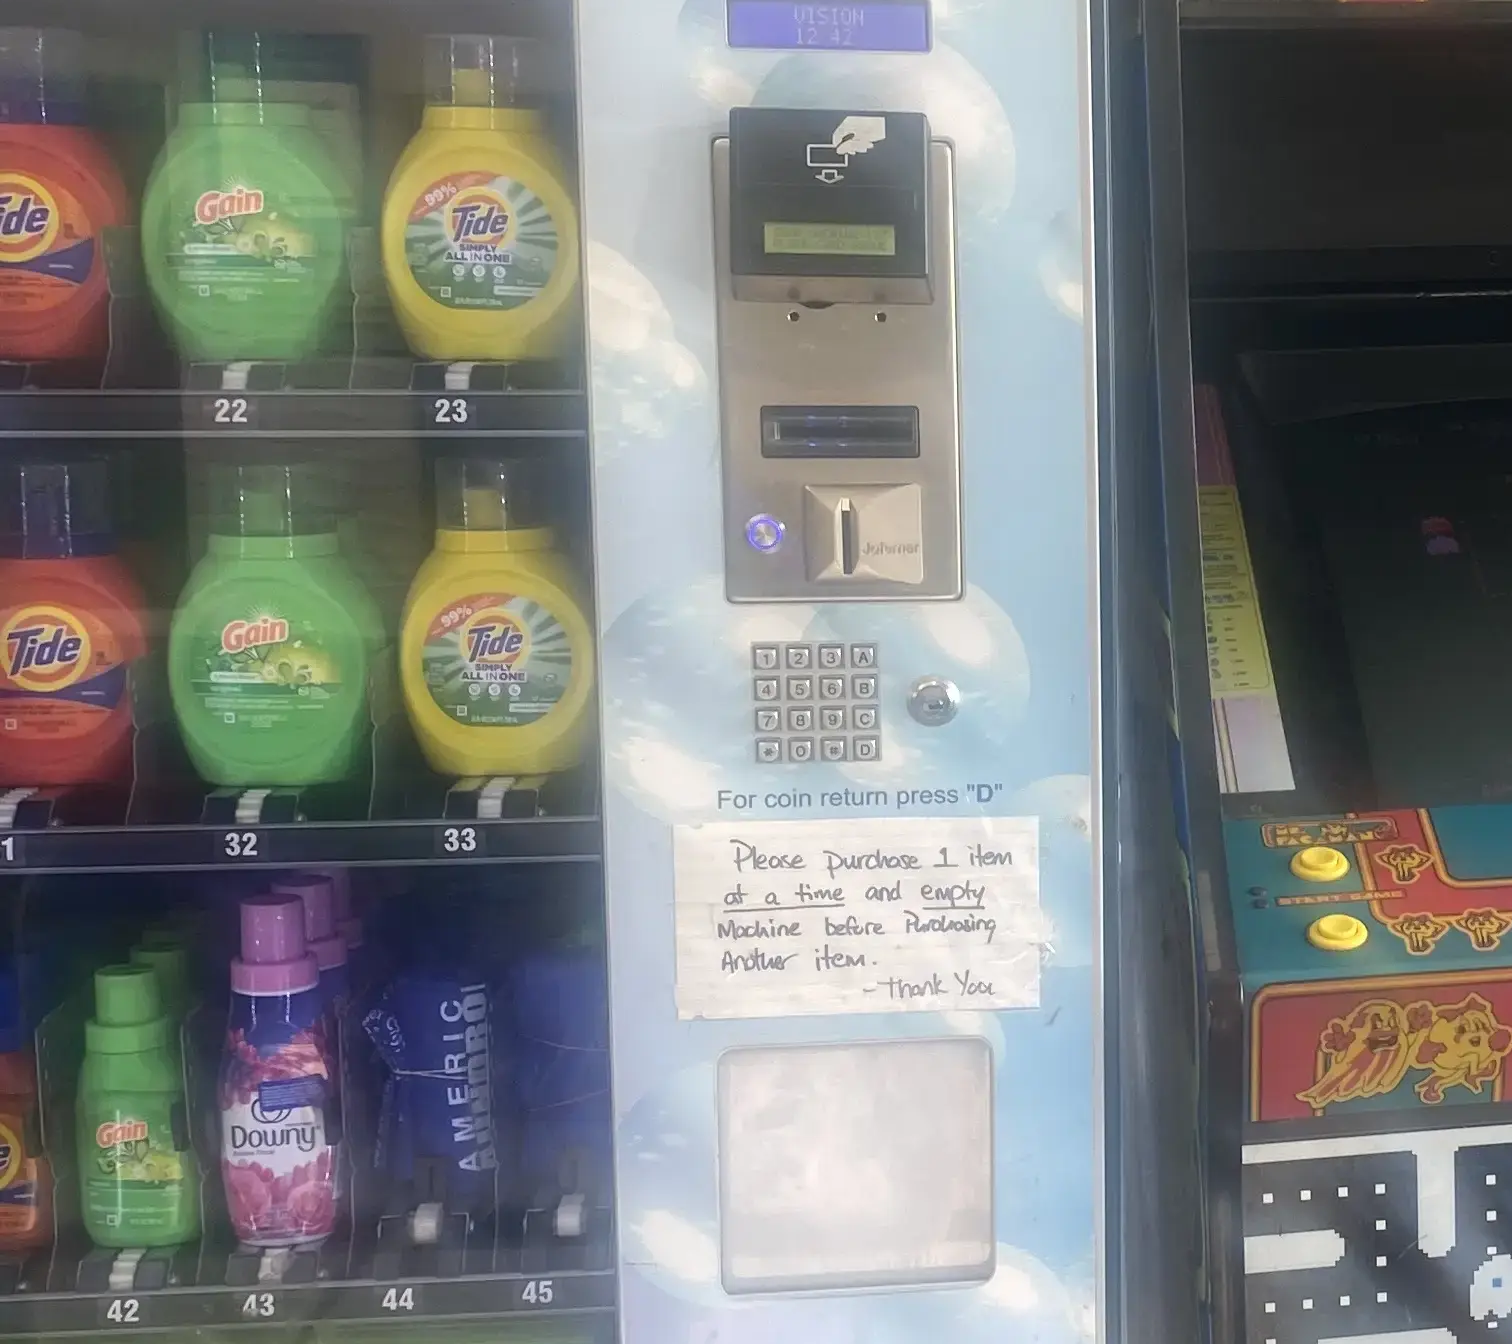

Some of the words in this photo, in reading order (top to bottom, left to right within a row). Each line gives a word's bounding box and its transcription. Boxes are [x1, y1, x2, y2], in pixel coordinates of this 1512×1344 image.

[794, 7, 865, 27] VISION
[196, 186, 264, 224] Gain
[424, 182, 457, 206] 99%
[0, 195, 50, 236] de
[452, 205, 509, 242] Tide
[446, 252, 469, 261] ALL
[470, 252, 483, 261] IN
[484, 253, 511, 263] ONE
[459, 244, 498, 252] SIMPLY
[214, 398, 248, 424] 22
[434, 398, 468, 424] 23
[441, 604, 472, 627] 99%
[222, 616, 289, 654] Gain
[468, 625, 524, 662] Tide
[7, 627, 82, 676] Tide
[461, 671, 484, 681] ALL
[485, 672, 498, 681] IN
[499, 672, 526, 681] ONE
[475, 663, 513, 672] SIMPLY
[717, 788, 757, 809] For
[764, 787, 812, 809] coin
[820, 787, 889, 808] return
[895, 786, 960, 810] press
[966, 783, 1004, 804] "D"
[2, 836, 14, 859] 1
[225, 832, 258, 857] 32
[444, 828, 477, 853] 33
[730, 838, 807, 873] Please
[932, 847, 960, 869] 1
[969, 844, 1013, 867] item
[723, 890, 749, 907] at
[765, 891, 781, 907] a
[794, 883, 846, 904] time
[865, 879, 902, 901] and
[920, 883, 986, 908] empty
[825, 916, 886, 937] before
[721, 949, 799, 973] Another
[96, 1120, 148, 1148] Gain
[231, 1125, 316, 1152] Downy
[242, 1293, 275, 1317] 43
[382, 1288, 414, 1312] 44
[522, 1281, 553, 1305] 45
[107, 1299, 139, 1324] 42
